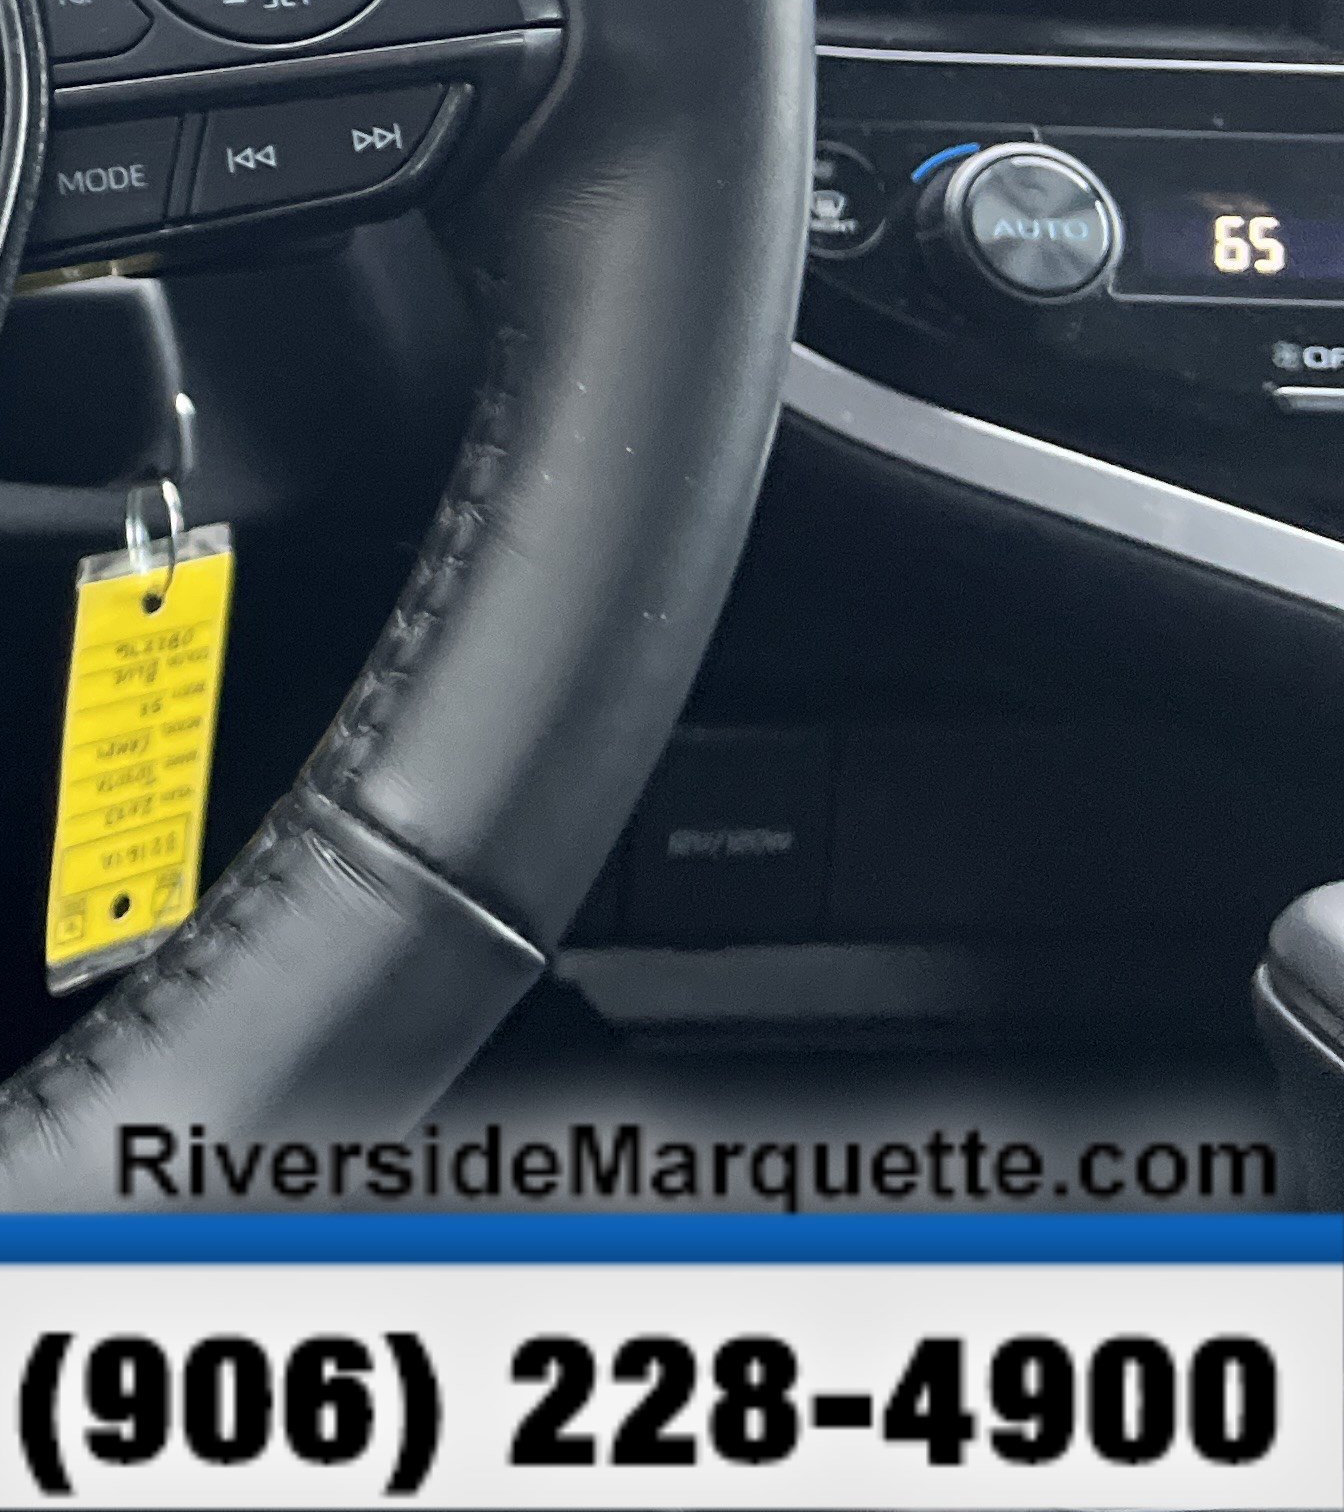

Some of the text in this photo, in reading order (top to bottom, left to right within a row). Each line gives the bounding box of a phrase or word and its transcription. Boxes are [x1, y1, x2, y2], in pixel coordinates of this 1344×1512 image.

[55, 163, 149, 197] MODE
[990, 217, 1092, 244] AUTO
[1212, 214, 1286, 275] 65
